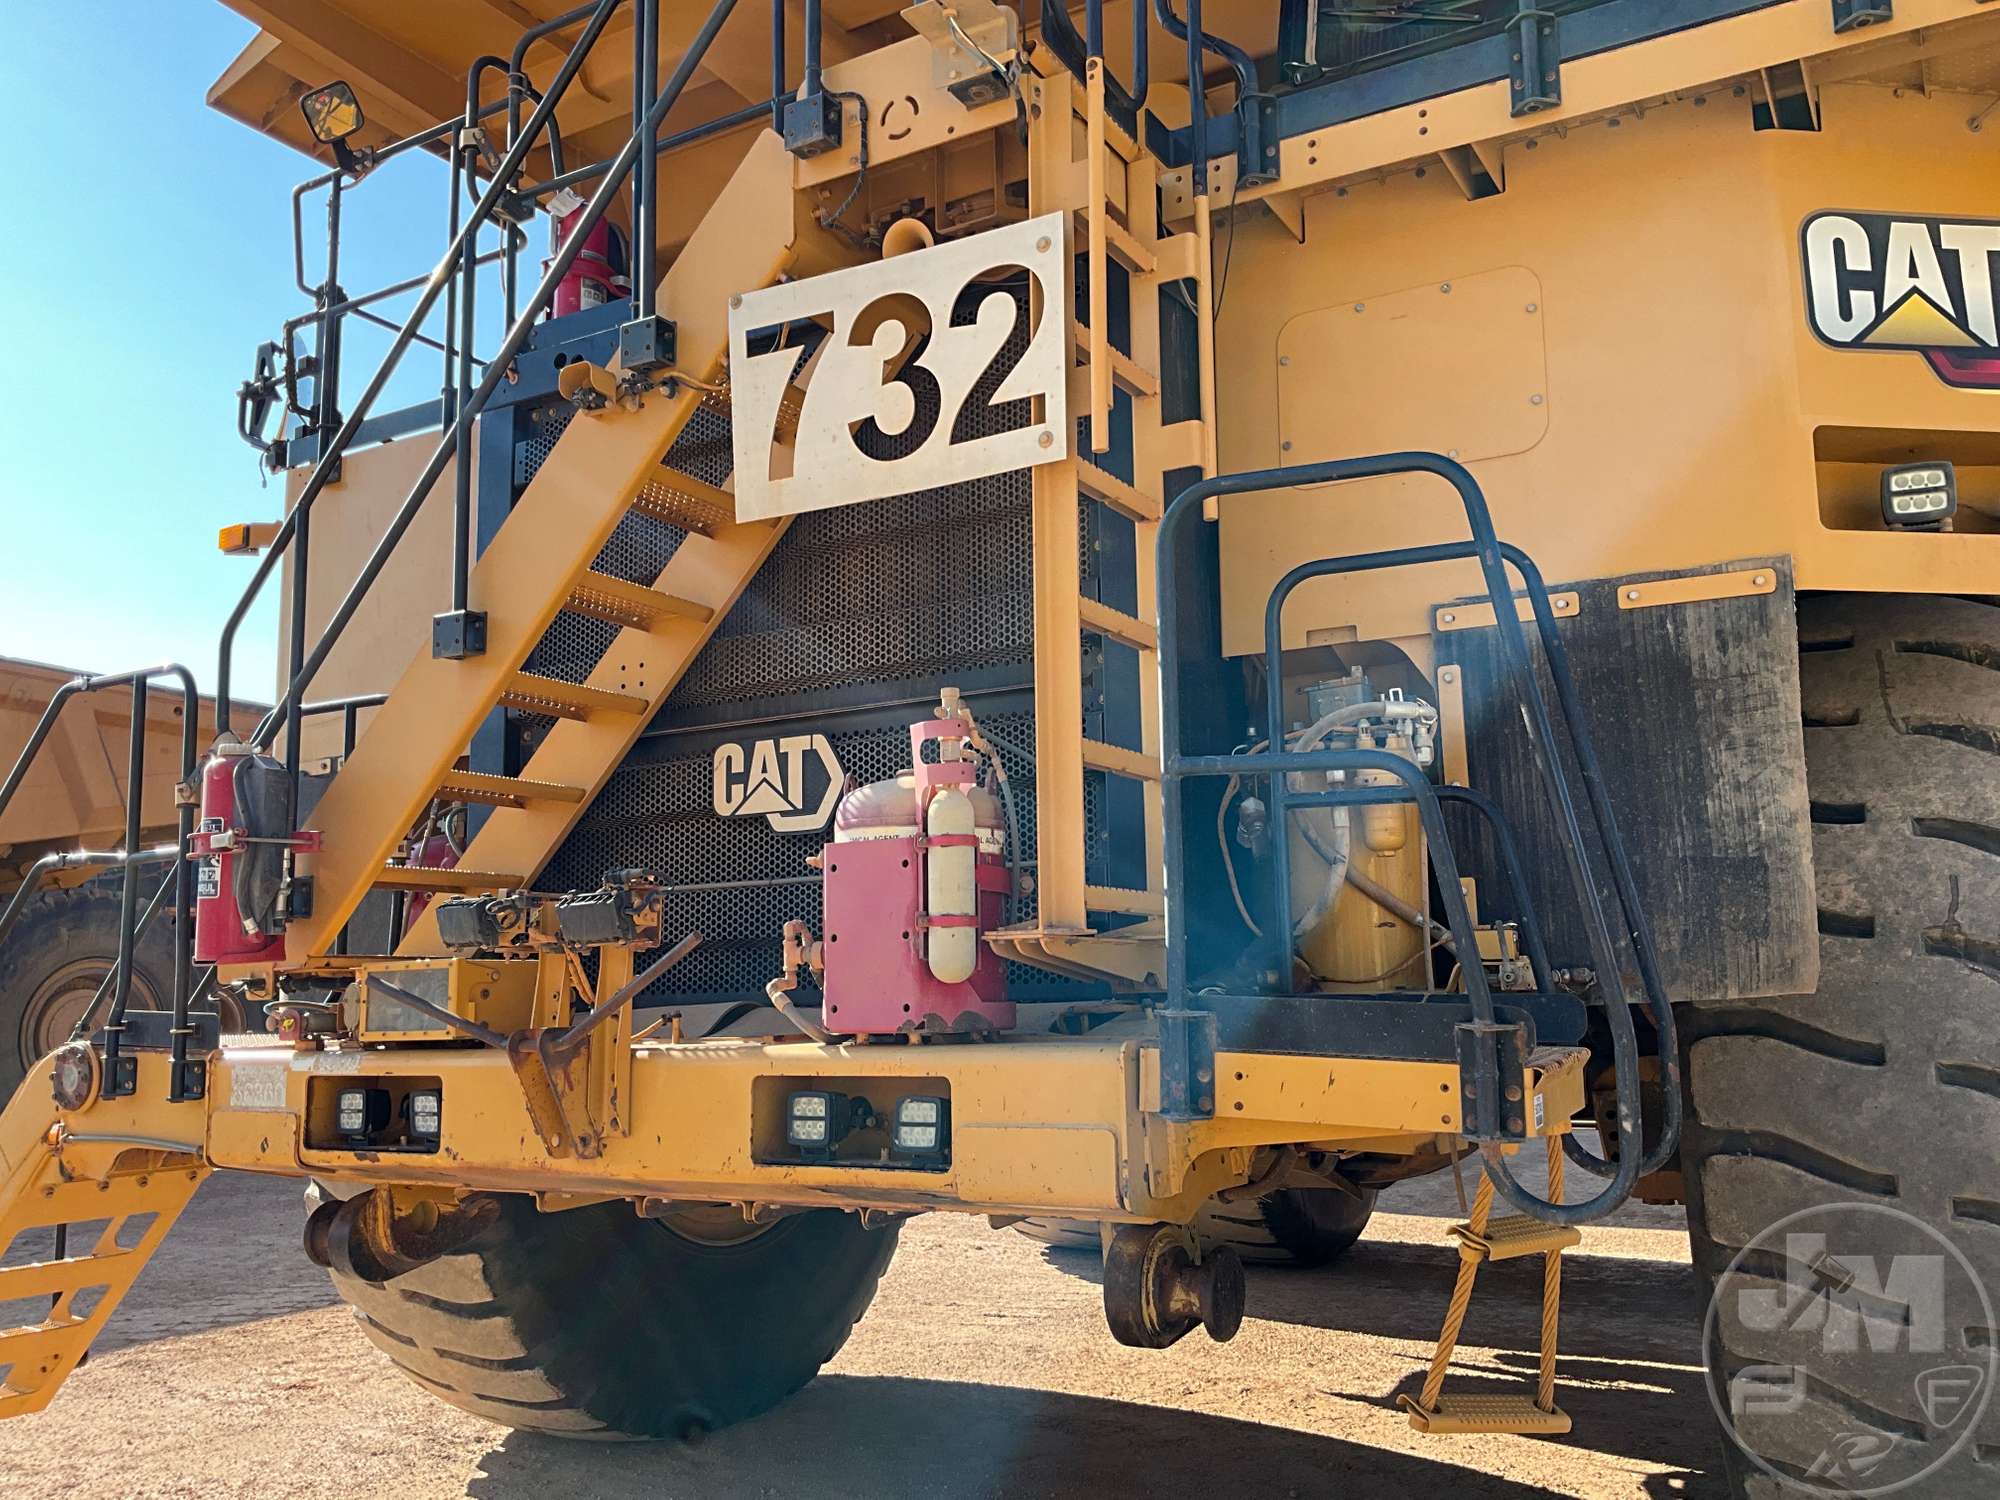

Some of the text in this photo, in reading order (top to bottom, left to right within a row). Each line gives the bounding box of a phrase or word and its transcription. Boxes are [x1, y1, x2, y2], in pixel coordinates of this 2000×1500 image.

[1806, 215, 2000, 348] CAT
[745, 263, 1046, 482] 732
[713, 734, 813, 817] CAT
